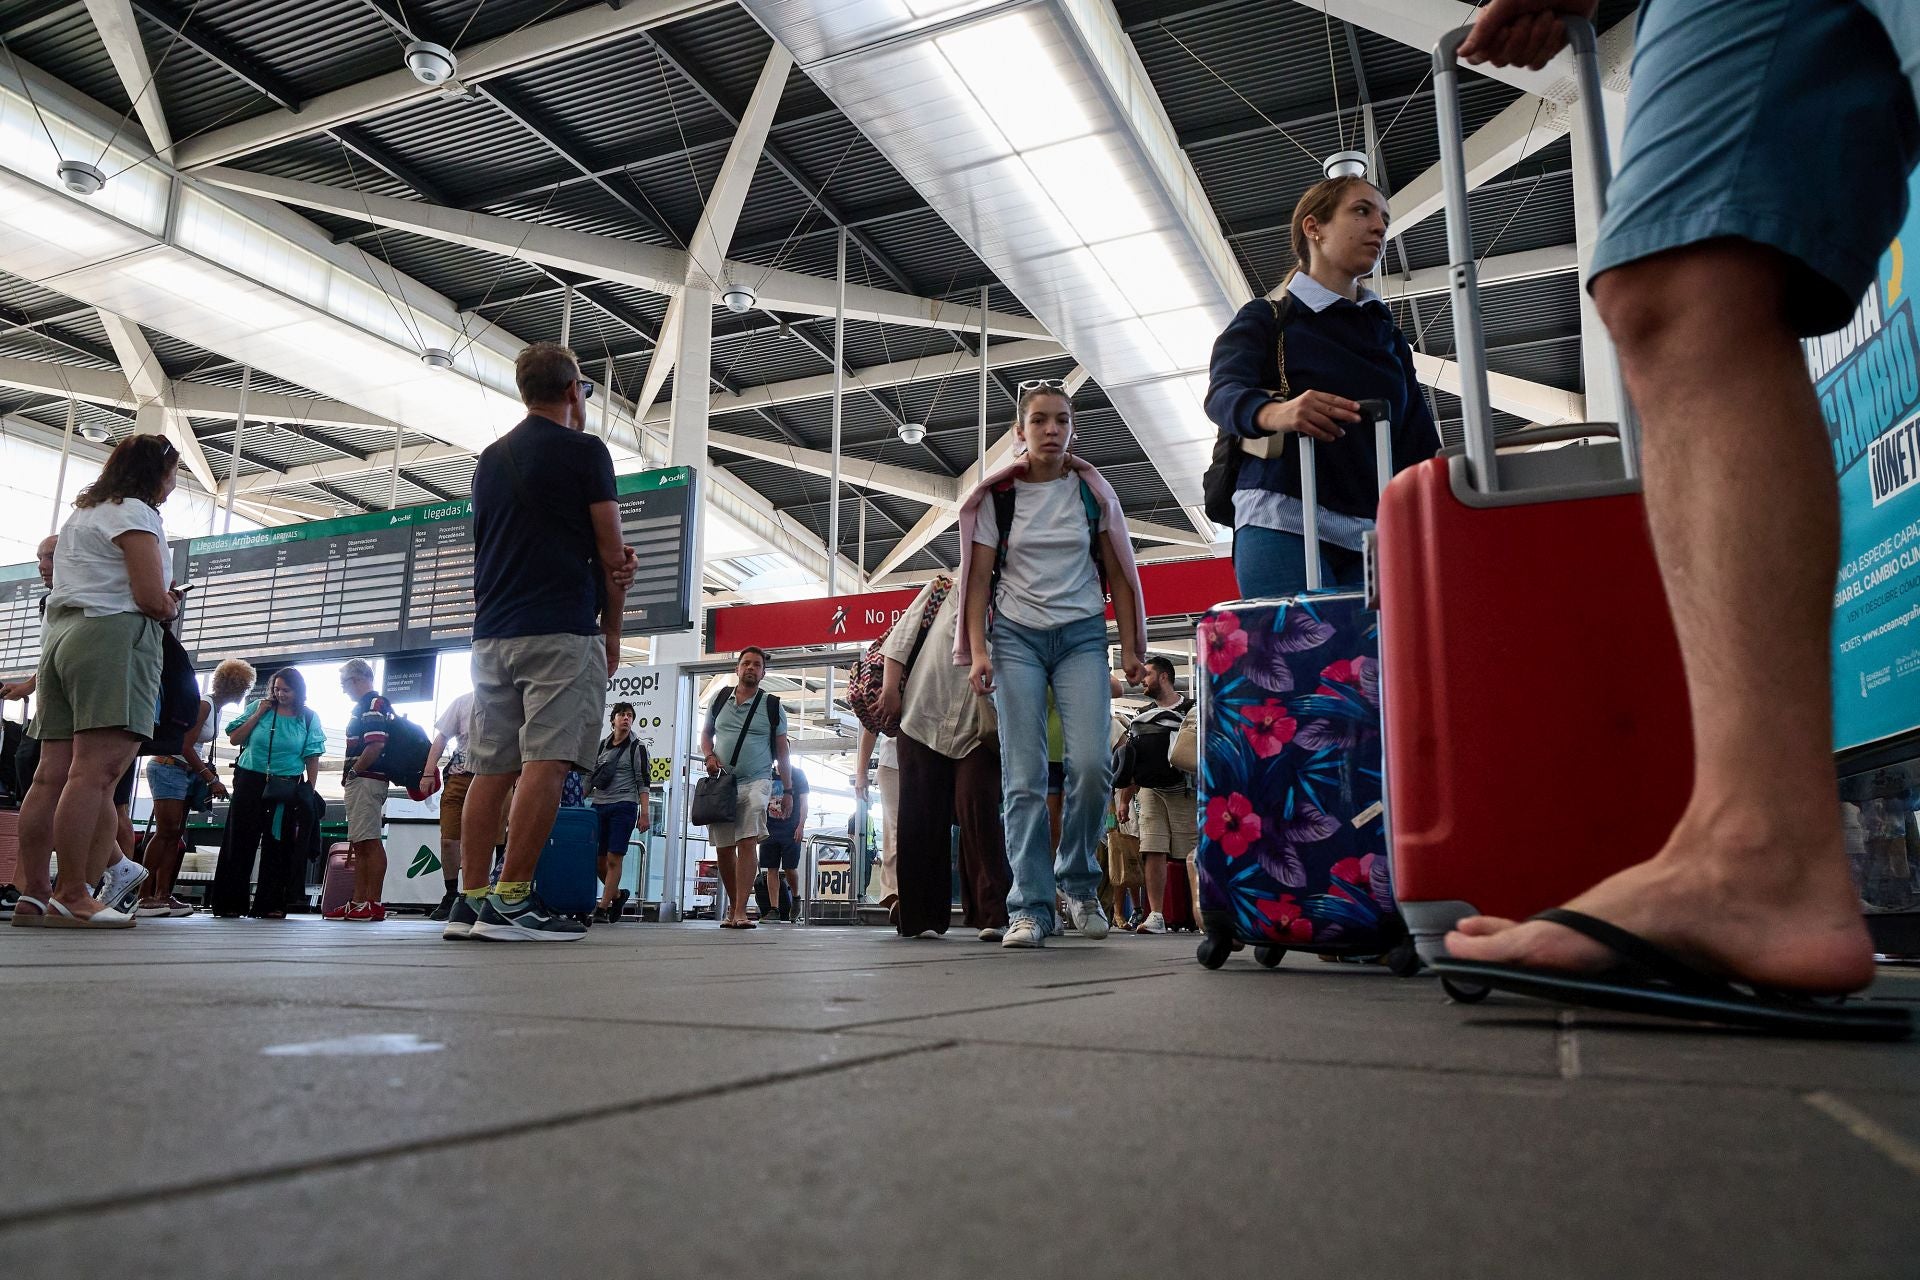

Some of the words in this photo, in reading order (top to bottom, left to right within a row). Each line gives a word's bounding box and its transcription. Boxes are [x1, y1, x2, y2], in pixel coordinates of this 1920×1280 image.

[1820, 310, 1919, 477] CAMBIO
[423, 505, 461, 520] Llegadas
[231, 533, 269, 547] Arribades
[272, 530, 298, 541] ARRIVALS
[1858, 537, 1893, 571] ESPECIE
[1853, 580, 1864, 597] EL
[1863, 558, 1899, 590] CAMBIO
[865, 608, 885, 625] No
[1840, 634, 1862, 653] TICKETS
